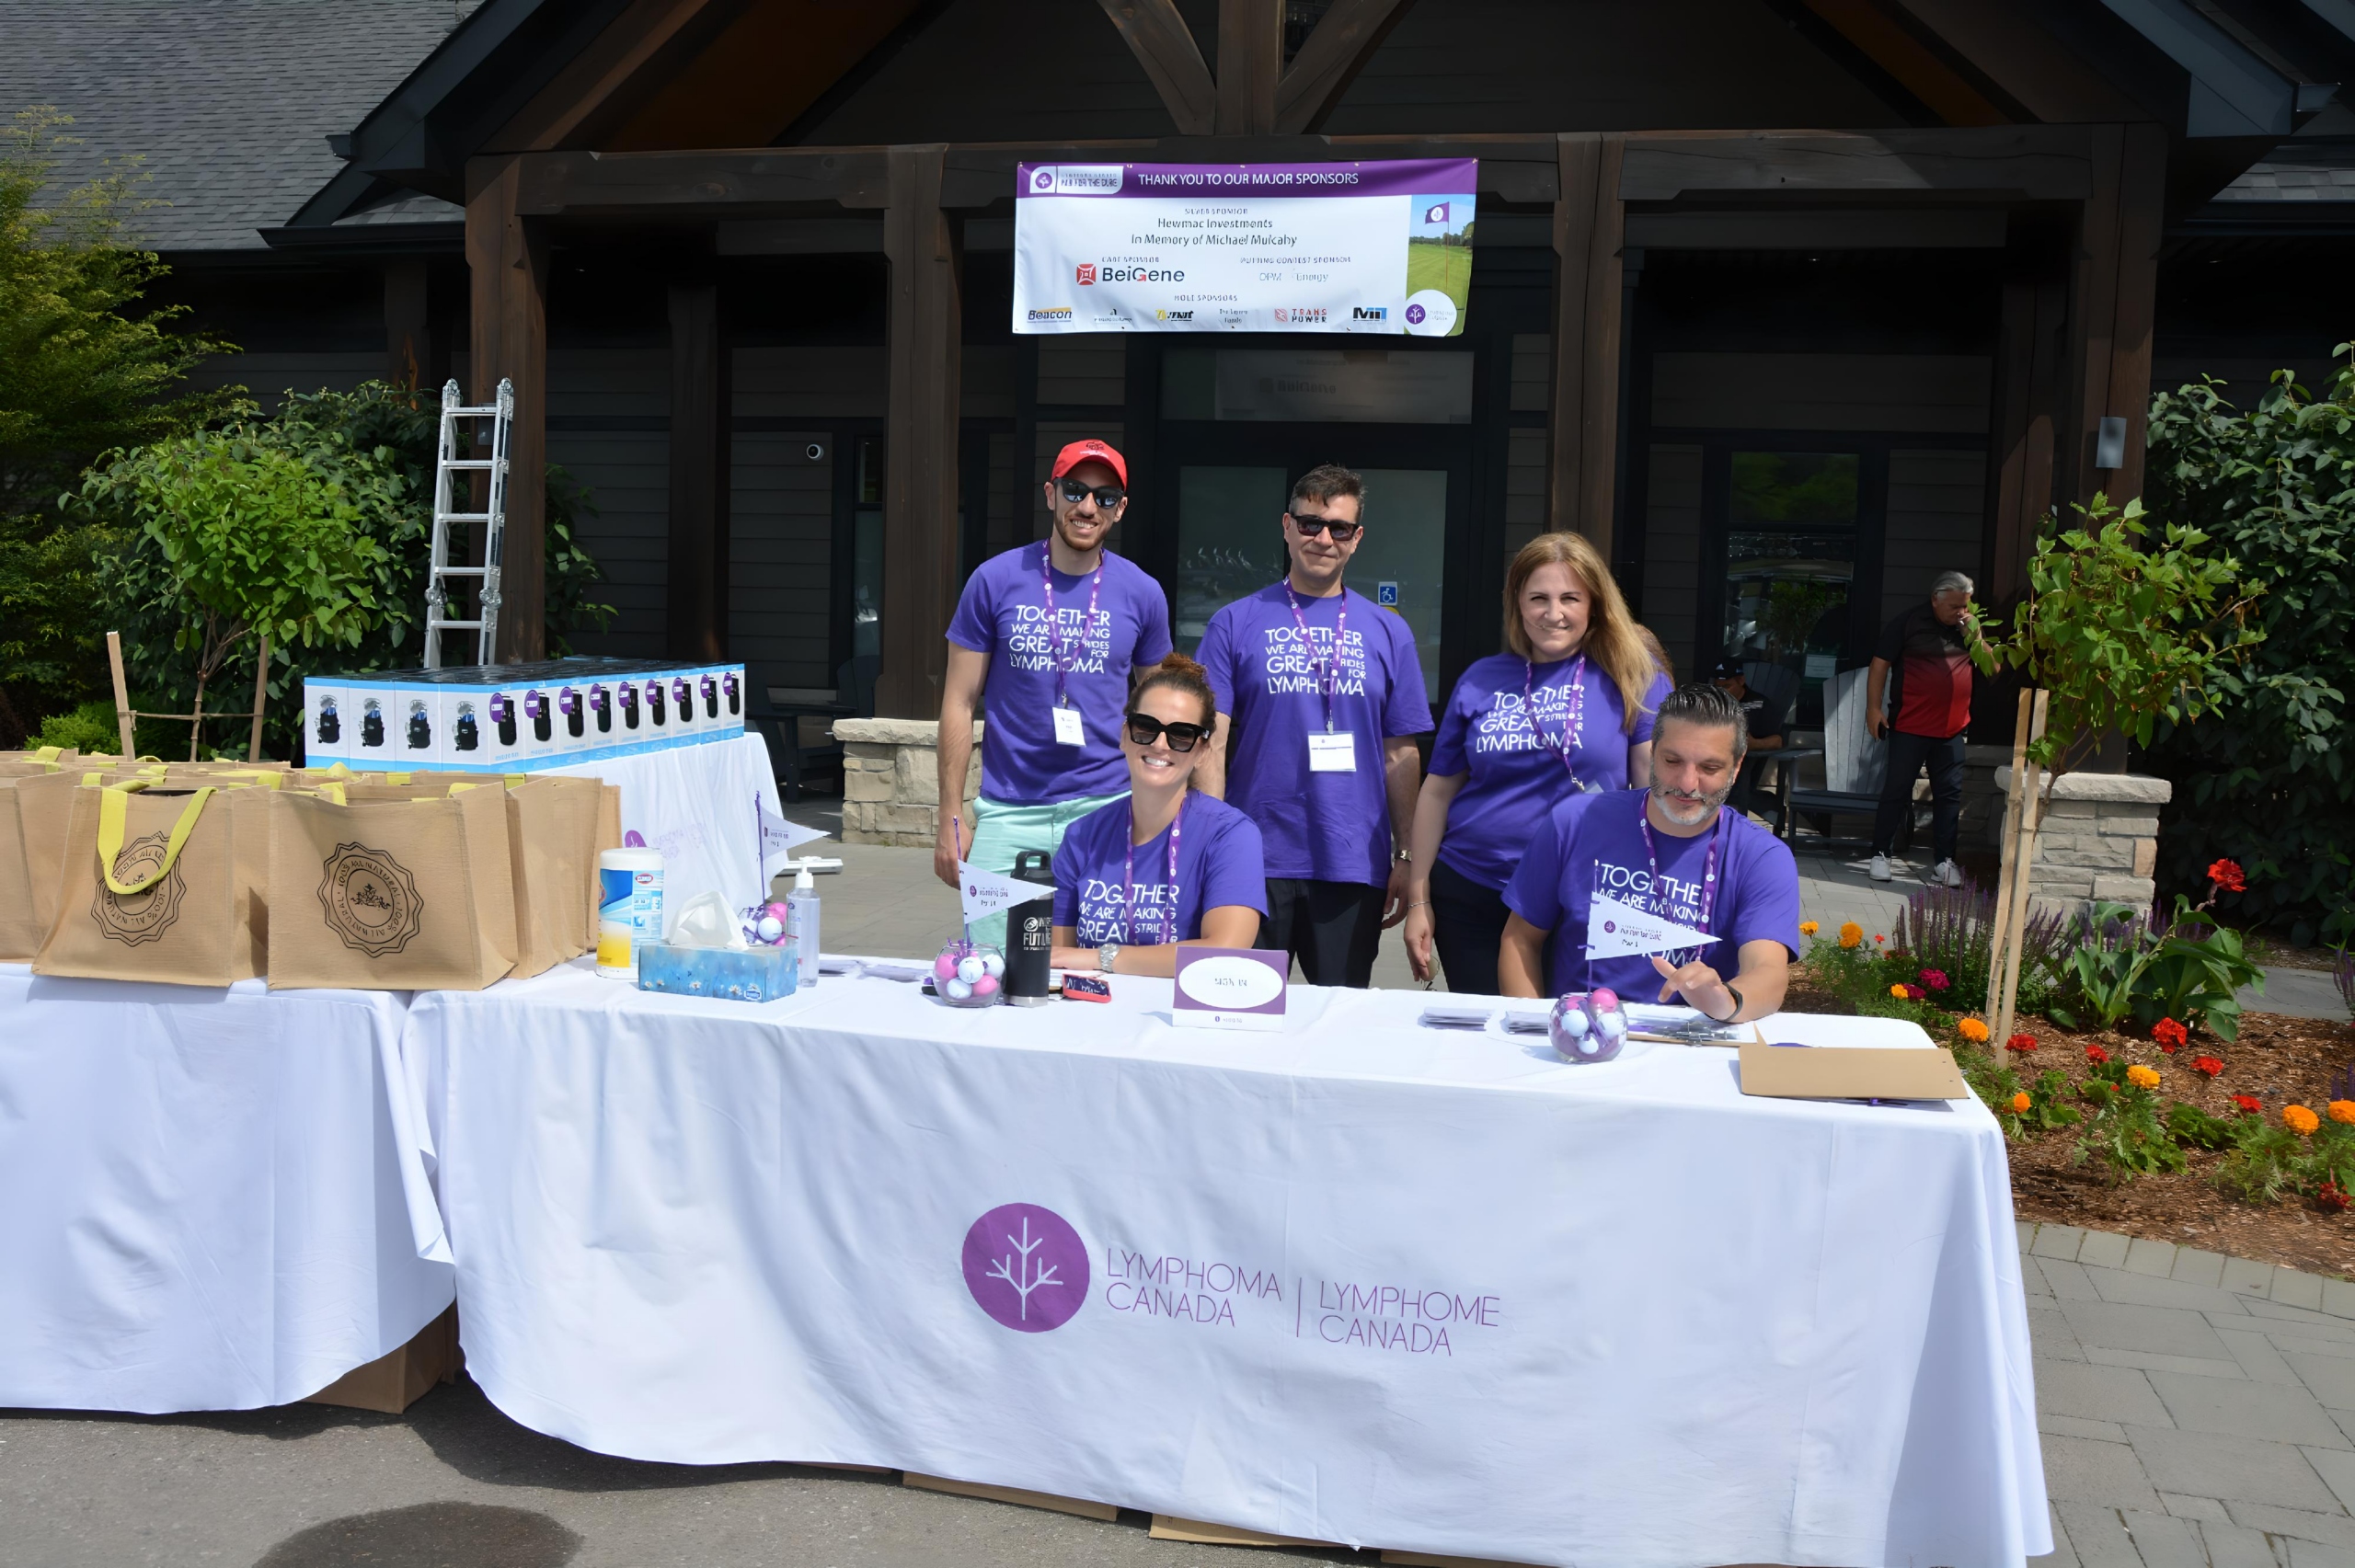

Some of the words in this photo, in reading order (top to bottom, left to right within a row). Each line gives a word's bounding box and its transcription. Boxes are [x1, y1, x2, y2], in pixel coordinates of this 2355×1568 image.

[1138, 174, 1178, 185] THANK
[1178, 174, 1203, 185] YOU
[1206, 174, 1222, 185] TO
[1224, 173, 1249, 185] OUR
[1252, 173, 1292, 185] MAJOR
[1296, 173, 1359, 184] SPONSORS
[1157, 218, 1204, 228] Hewmac
[1207, 218, 1273, 228] Investments
[1132, 235, 1143, 245] In
[1144, 235, 1189, 246] Memory
[1192, 234, 1204, 245] of
[1205, 234, 1249, 246] Michael
[1251, 235, 1297, 247] Mulcahy
[1313, 256, 1351, 264] SPONSOR
[1102, 266, 1185, 281] BeiGene
[1028, 309, 1072, 321] Beacon
[1292, 308, 1327, 316] TRANS
[1011, 624, 1031, 635] WE
[1032, 624, 1051, 635] AR
[1090, 648, 1109, 659] FOR
[1265, 644, 1286, 656] WE
[1314, 645, 1365, 659] MAING
[1084, 878, 1180, 904] TOGTHER
[1619, 892, 1648, 910] ARE
[1093, 906, 1117, 920] ARE
[1076, 916, 1129, 944] GREAT
[1134, 922, 1178, 933] STRIDS
[1107, 1247, 1281, 1301] LYMPHOMA
[1106, 1282, 1235, 1328] CANADA
[1319, 1280, 1500, 1327] LYMPHOME
[1318, 1315, 1452, 1356] CANADA
